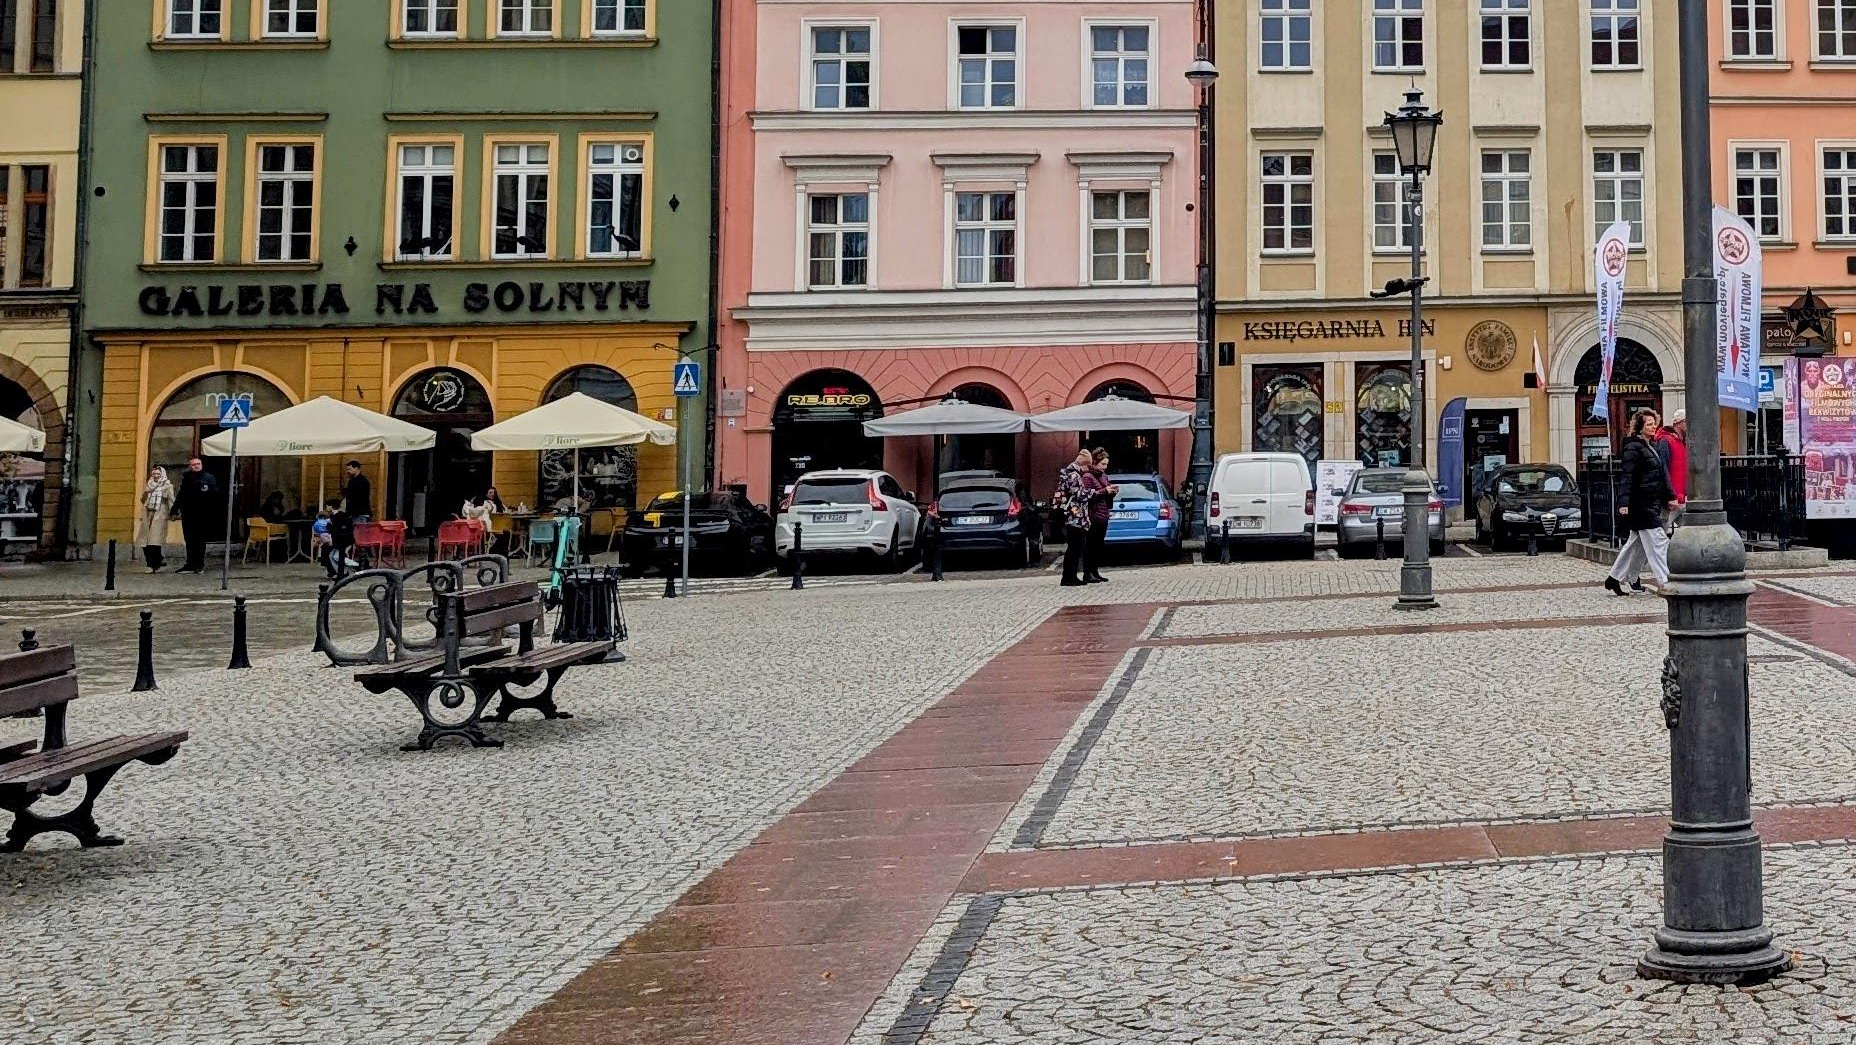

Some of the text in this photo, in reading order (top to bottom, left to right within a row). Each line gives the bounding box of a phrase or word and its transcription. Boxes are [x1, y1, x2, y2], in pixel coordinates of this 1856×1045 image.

[138, 280, 651, 316] GALERIA NA SOLNYM
[1243, 319, 1386, 343] KSIĘGARNIA
[288, 442, 314, 452] fiore
[555, 435, 581, 445] fiore
